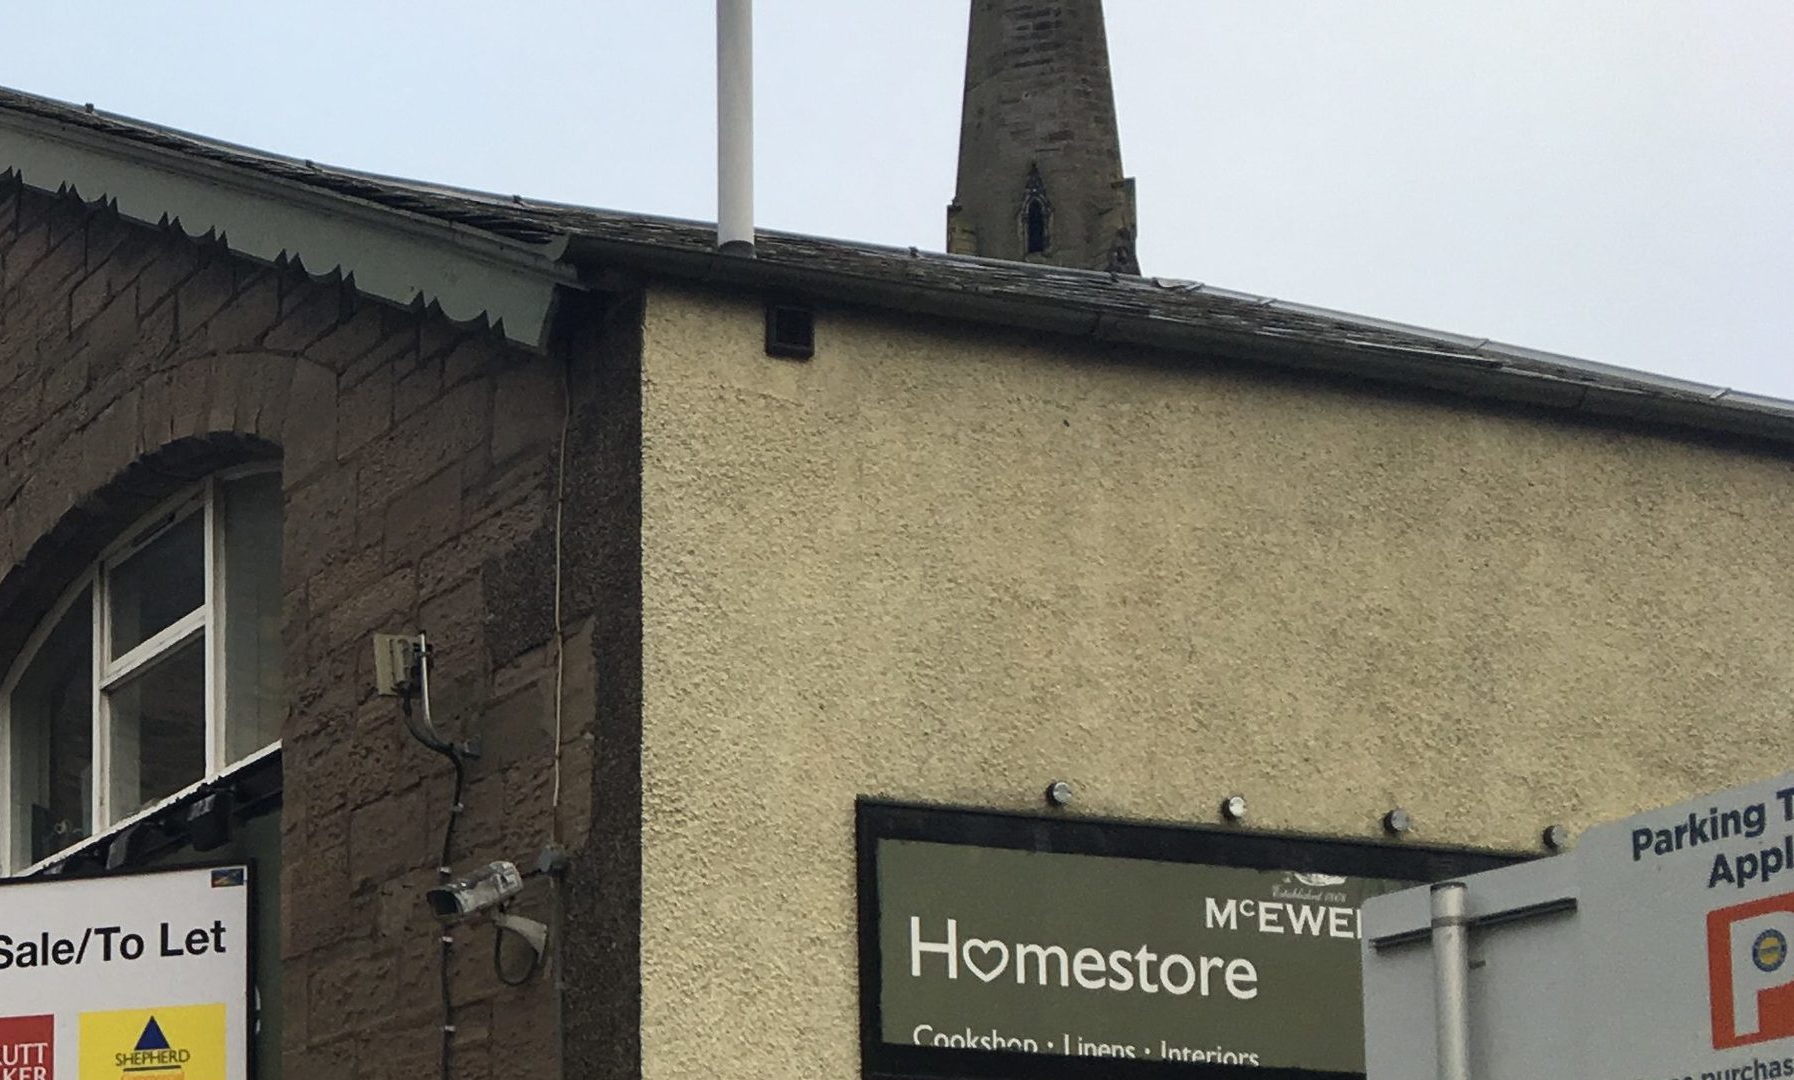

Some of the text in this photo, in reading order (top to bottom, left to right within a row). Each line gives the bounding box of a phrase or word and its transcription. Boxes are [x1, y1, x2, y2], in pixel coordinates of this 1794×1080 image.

[1632, 803, 1765, 861] Parking
[1205, 897, 1362, 940] McEWE
[160, 920, 227, 957] Let
[115, 1048, 191, 1067] SHEPHERD
[1161, 1040, 1260, 1067] Interiors
